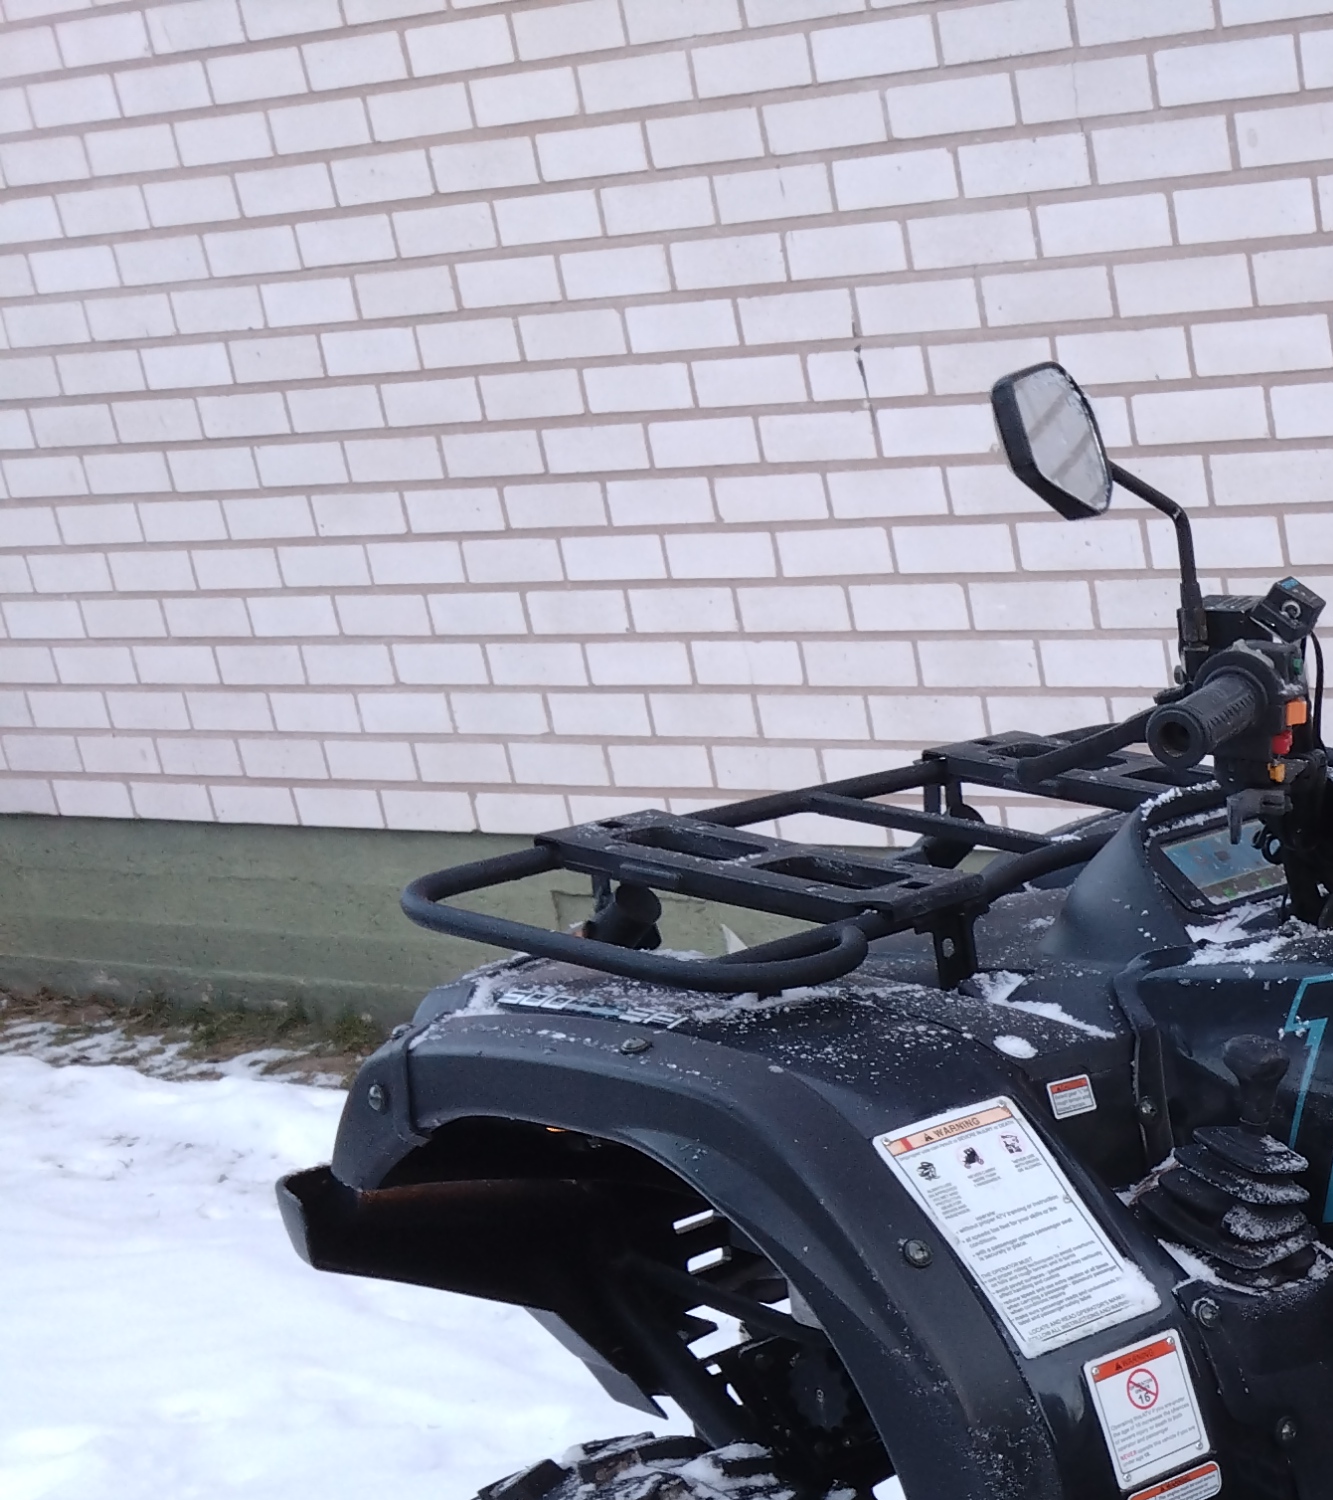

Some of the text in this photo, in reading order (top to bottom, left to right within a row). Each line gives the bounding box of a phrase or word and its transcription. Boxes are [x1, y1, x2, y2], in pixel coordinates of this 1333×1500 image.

[931, 1115, 982, 1139] WARNING
[1026, 1322, 1051, 1336] LOCATE
[1137, 1390, 1151, 1405] 16
